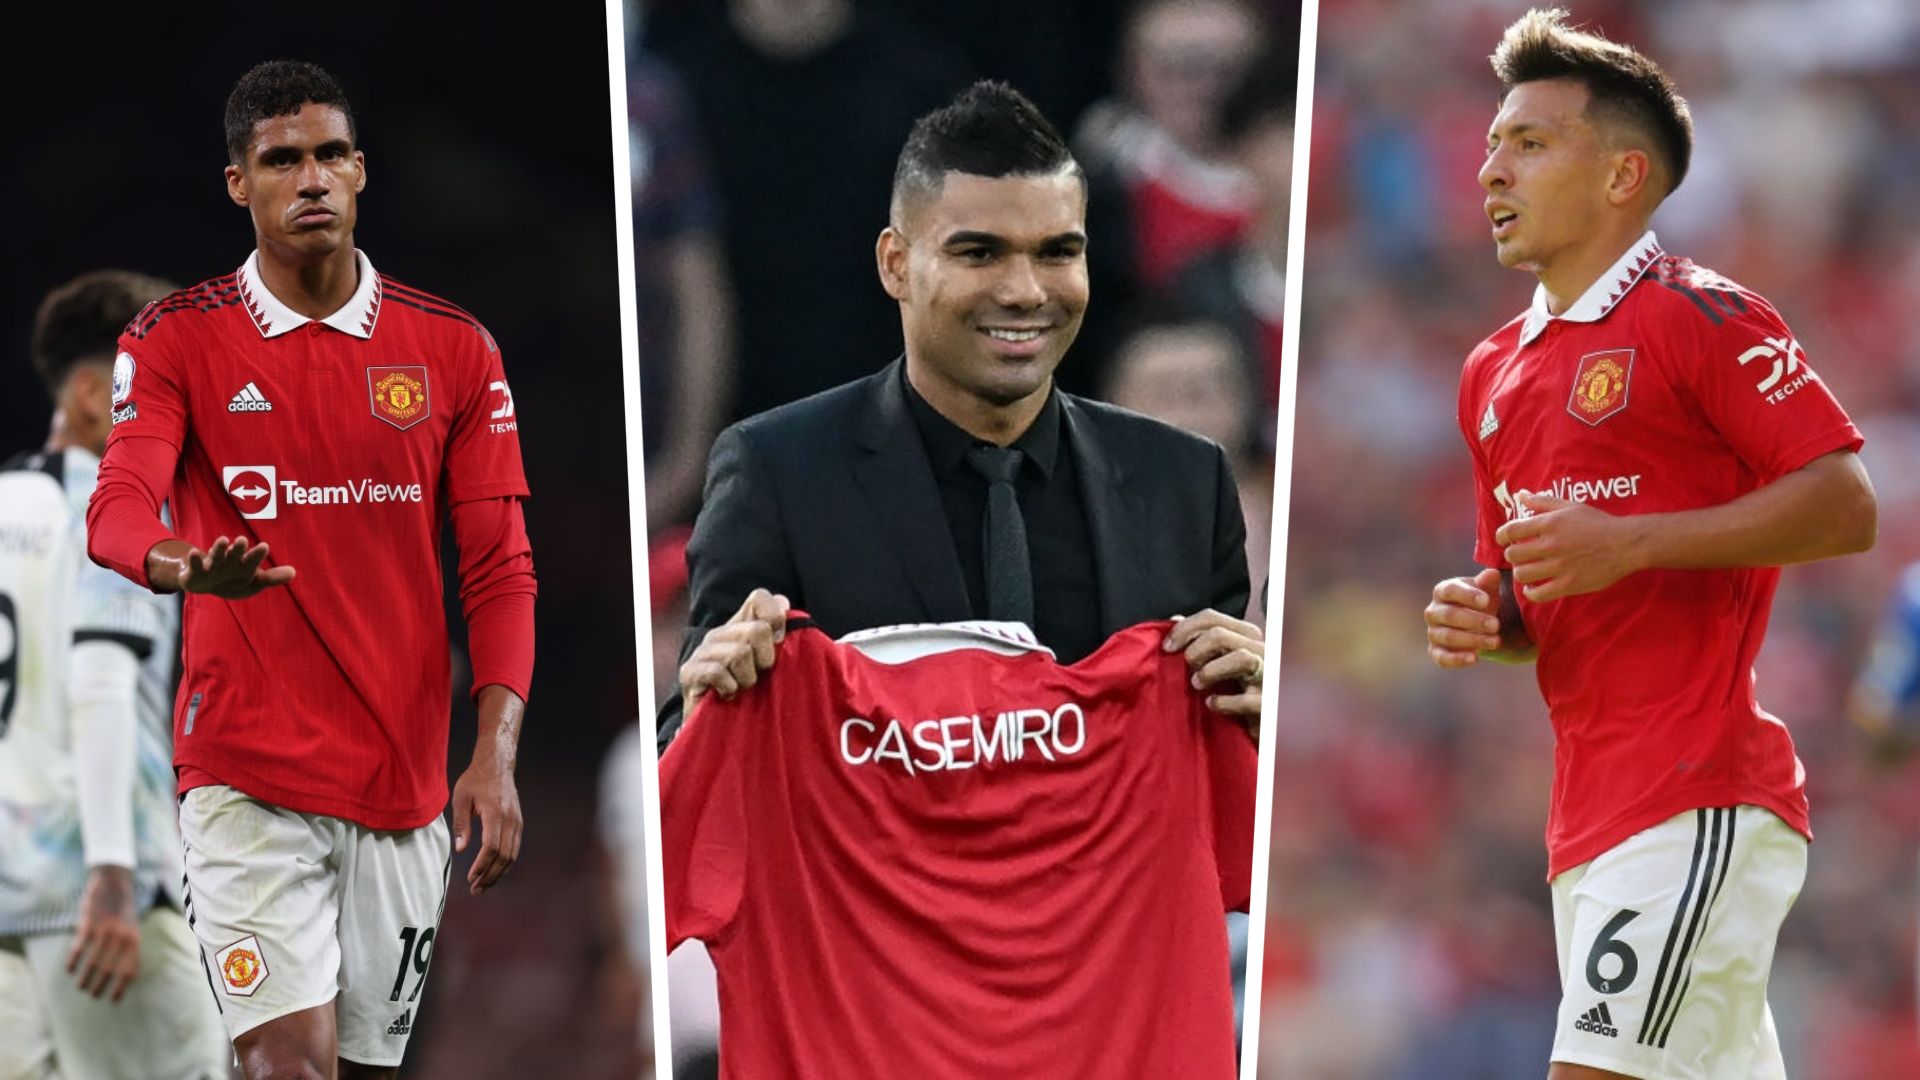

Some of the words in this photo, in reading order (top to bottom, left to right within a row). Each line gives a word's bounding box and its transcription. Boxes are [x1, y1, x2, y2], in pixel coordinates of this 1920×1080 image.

[228, 400, 273, 412] adidas
[280, 479, 423, 505] TeamViewe
[840, 702, 1086, 777] CASEMIRO
[389, 925, 436, 1003] 19
[1585, 908, 1642, 995] 6
[1574, 1019, 1619, 1038] adidas
